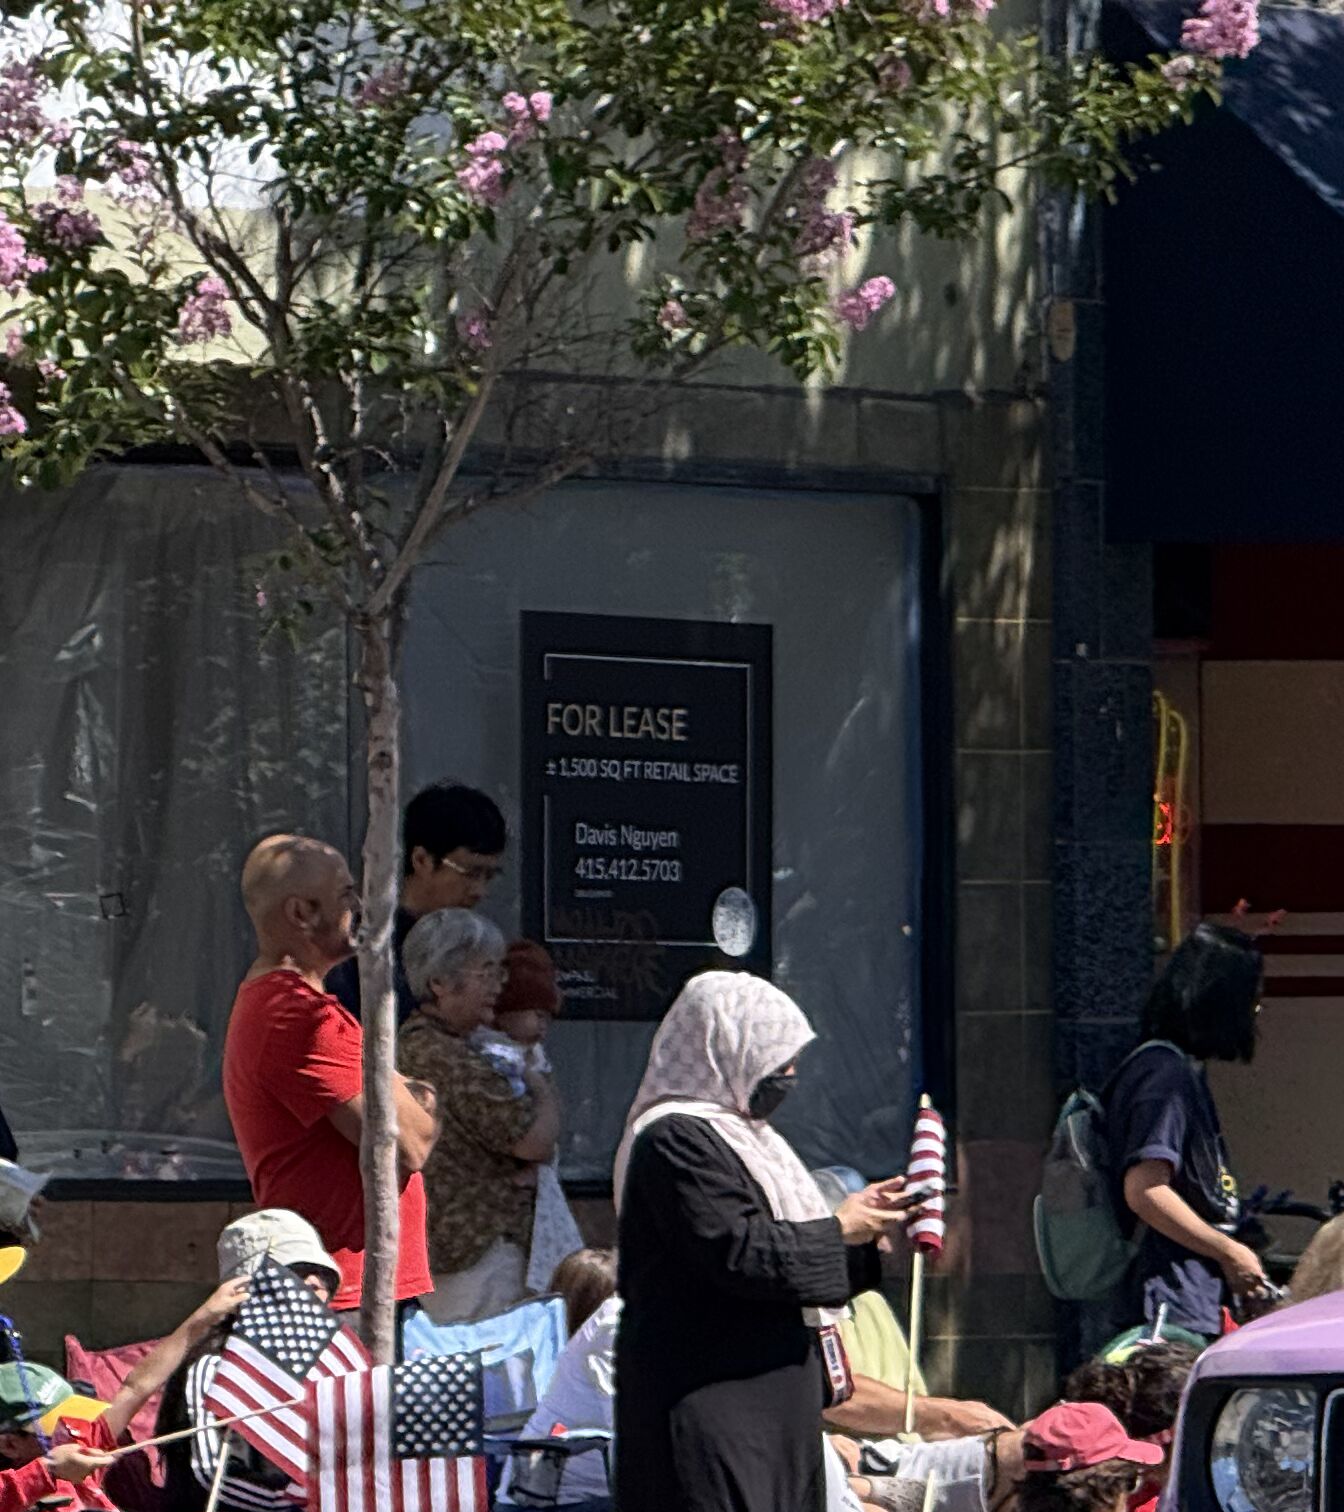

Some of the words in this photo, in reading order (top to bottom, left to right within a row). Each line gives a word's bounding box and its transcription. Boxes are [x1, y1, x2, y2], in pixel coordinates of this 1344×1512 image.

[547, 703, 601, 736] FOR
[609, 706, 689, 741] LEASE
[558, 758, 598, 778] 1,500
[600, 760, 623, 781] SQ
[623, 761, 641, 779] FT
[643, 762, 692, 783] RETAIL
[692, 764, 741, 784] SPACE
[574, 823, 618, 846] Davis
[620, 825, 679, 850] Nguyen
[574, 858, 681, 883] 415.412.5703
